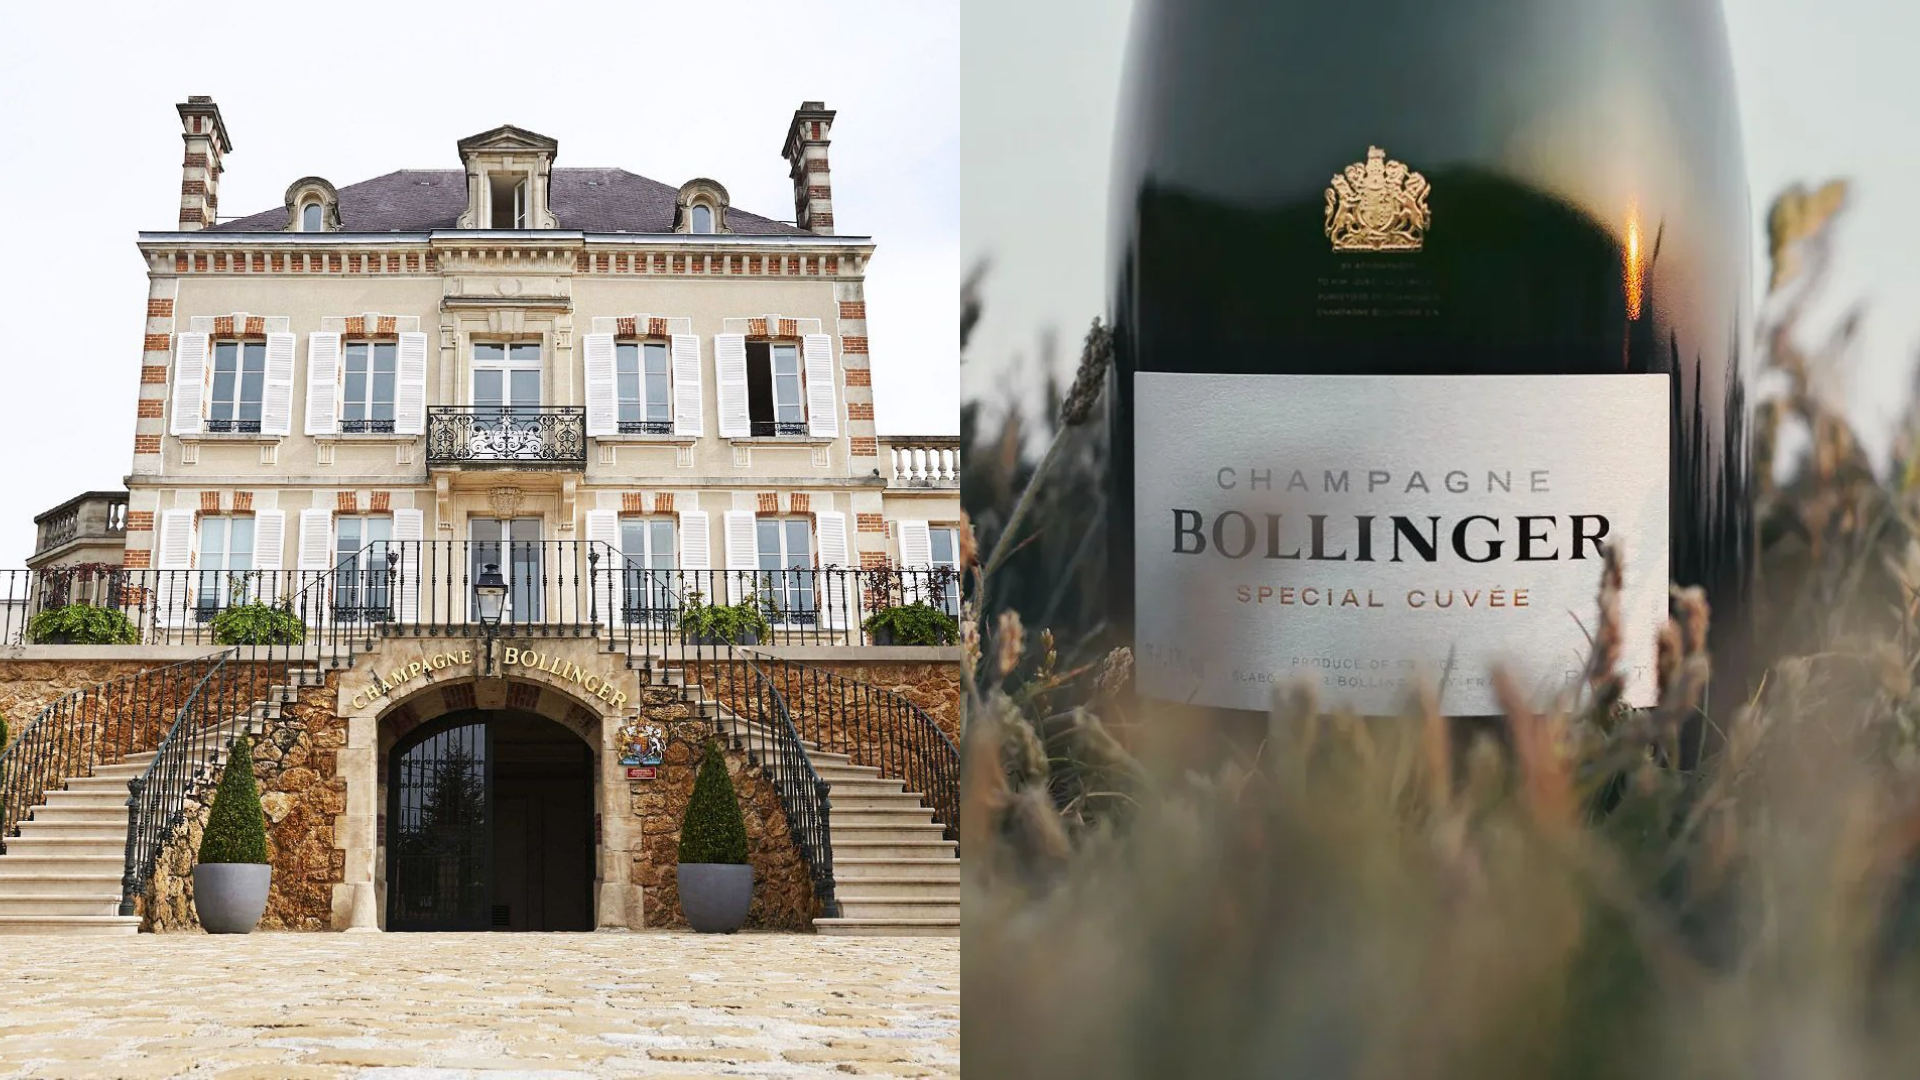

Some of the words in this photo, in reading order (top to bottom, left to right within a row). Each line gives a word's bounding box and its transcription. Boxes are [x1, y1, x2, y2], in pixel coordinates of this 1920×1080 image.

[1216, 467, 1550, 493] CHAMPAGNE
[1172, 508, 1611, 563] BOLLINGER
[1237, 585, 1384, 608] SPECIAL
[1407, 584, 1530, 609] CUVÉE
[351, 649, 473, 709] CHAMPAGNE
[503, 646, 628, 710] BOLLINGER
